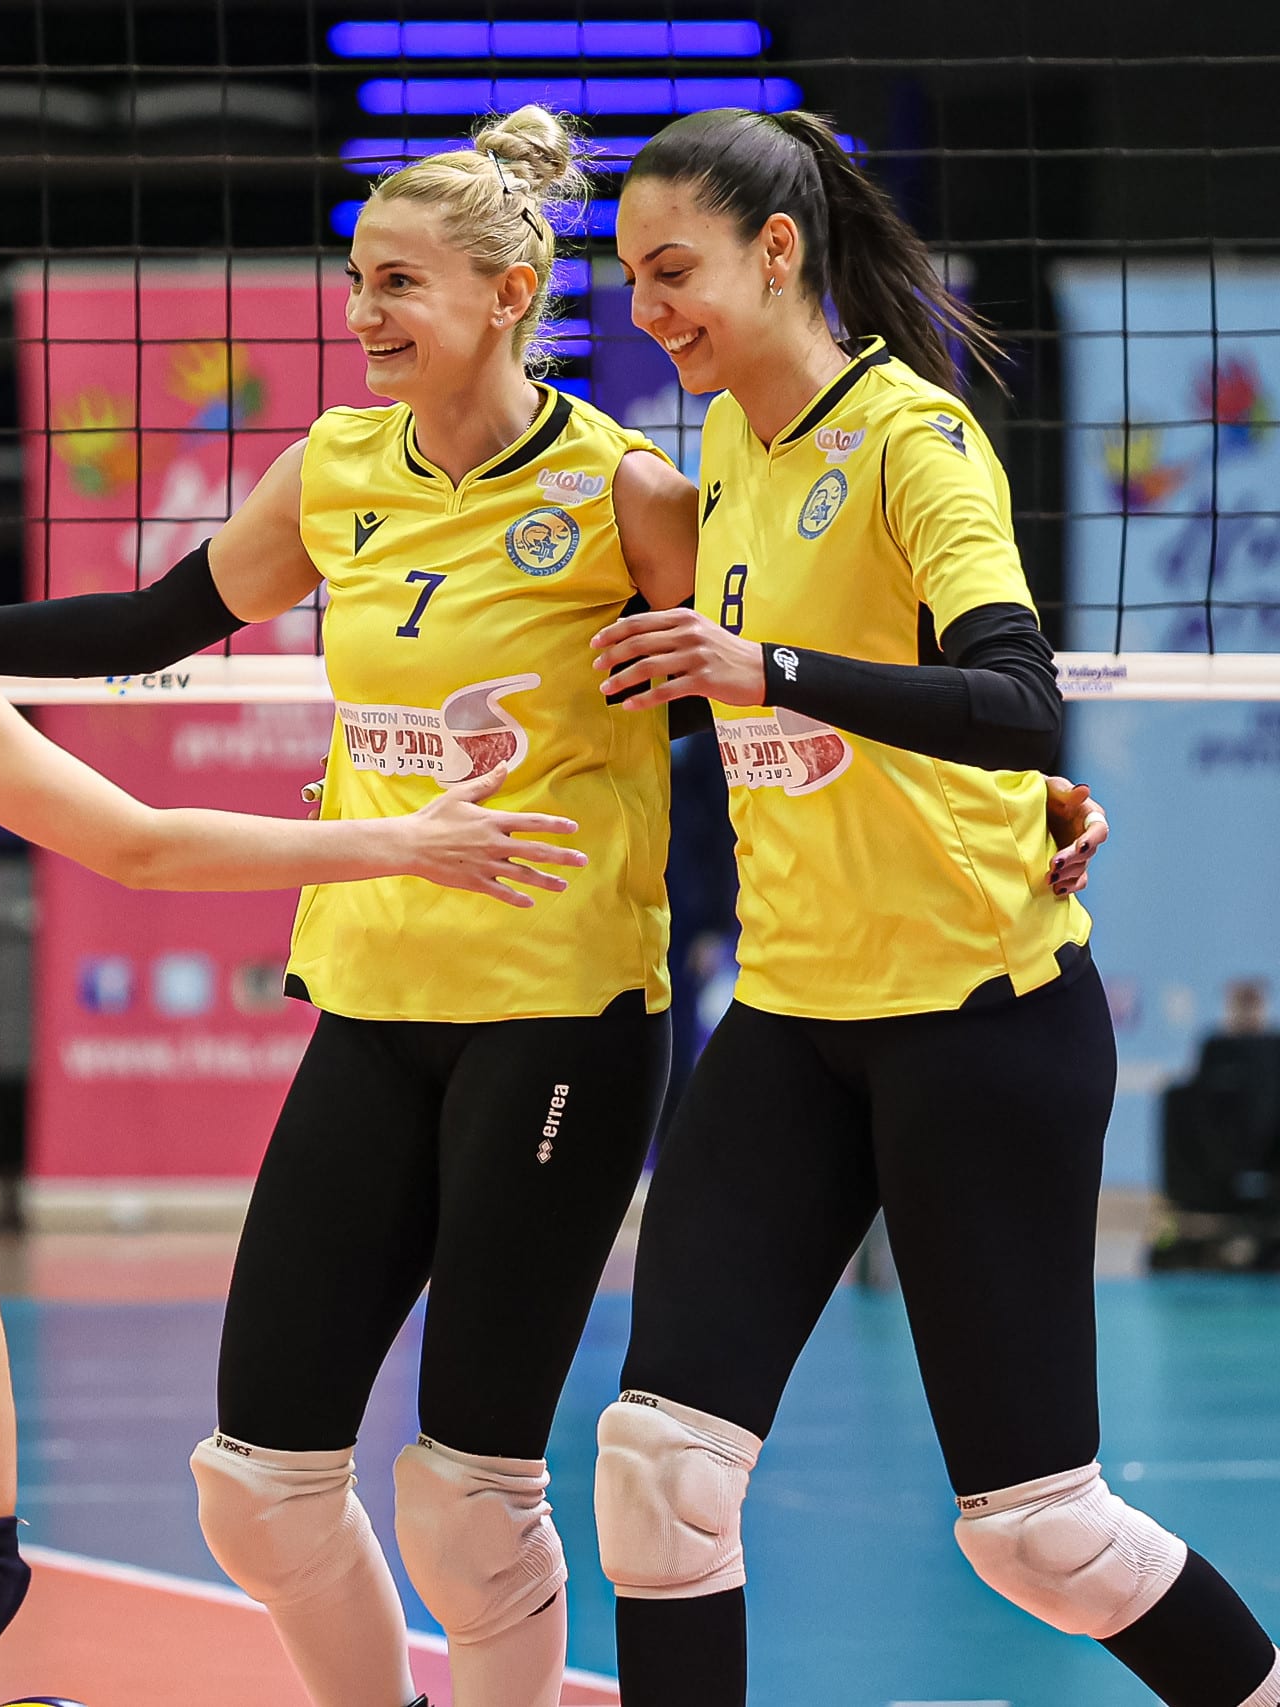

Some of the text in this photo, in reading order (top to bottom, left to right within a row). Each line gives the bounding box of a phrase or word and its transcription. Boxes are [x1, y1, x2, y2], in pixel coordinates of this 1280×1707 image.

[396, 570, 448, 638] 7
[720, 564, 748, 636] 8
[141, 674, 190, 689] CEV
[361, 711, 398, 725] SITON
[403, 712, 441, 729] TOURS
[745, 723, 780, 738] TOURS
[396, 729, 444, 758] מוני
[742, 740, 789, 767] מוני
[397, 756, 444, 771] בשביל
[746, 767, 793, 782] בשביל
[542, 1084, 570, 1138] errea
